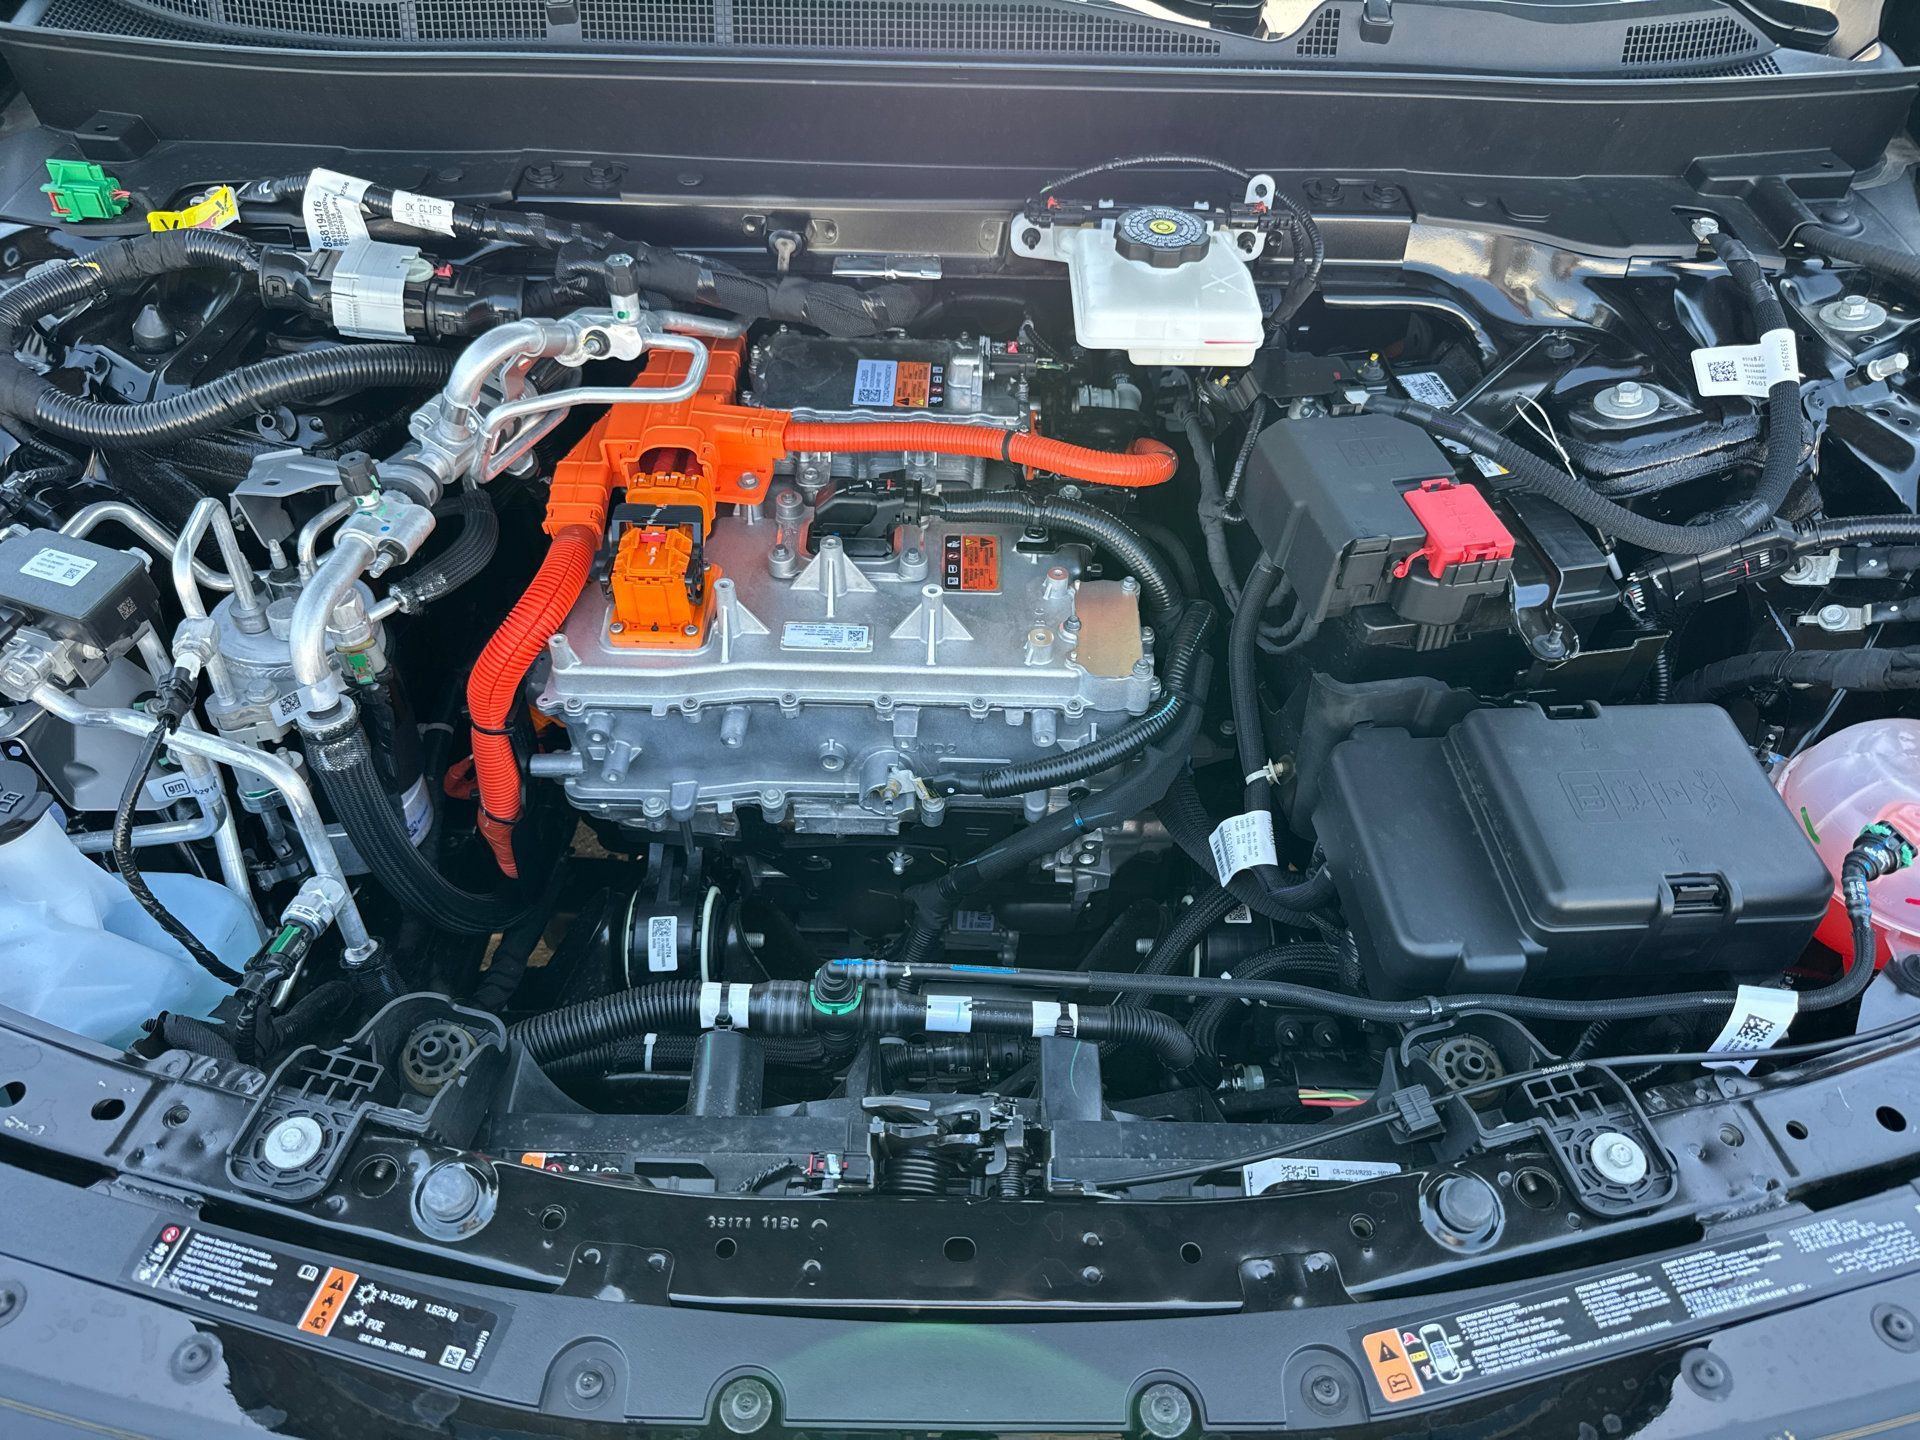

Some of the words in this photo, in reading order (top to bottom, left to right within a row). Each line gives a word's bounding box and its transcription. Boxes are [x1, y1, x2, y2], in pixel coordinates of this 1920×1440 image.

[405, 202, 415, 212] OK
[419, 204, 442, 215] CLIPS
[313, 200, 333, 247] 85819416
[168, 783, 185, 794] gm
[379, 1290, 418, 1309] R-1234yf
[425, 1303, 448, 1317] 1.625
[447, 1309, 459, 1322] kg
[1456, 1310, 1488, 1323] EMERGENCY
[1488, 1302, 1520, 1315] PERSONNEL:
[365, 1318, 385, 1332] POE
